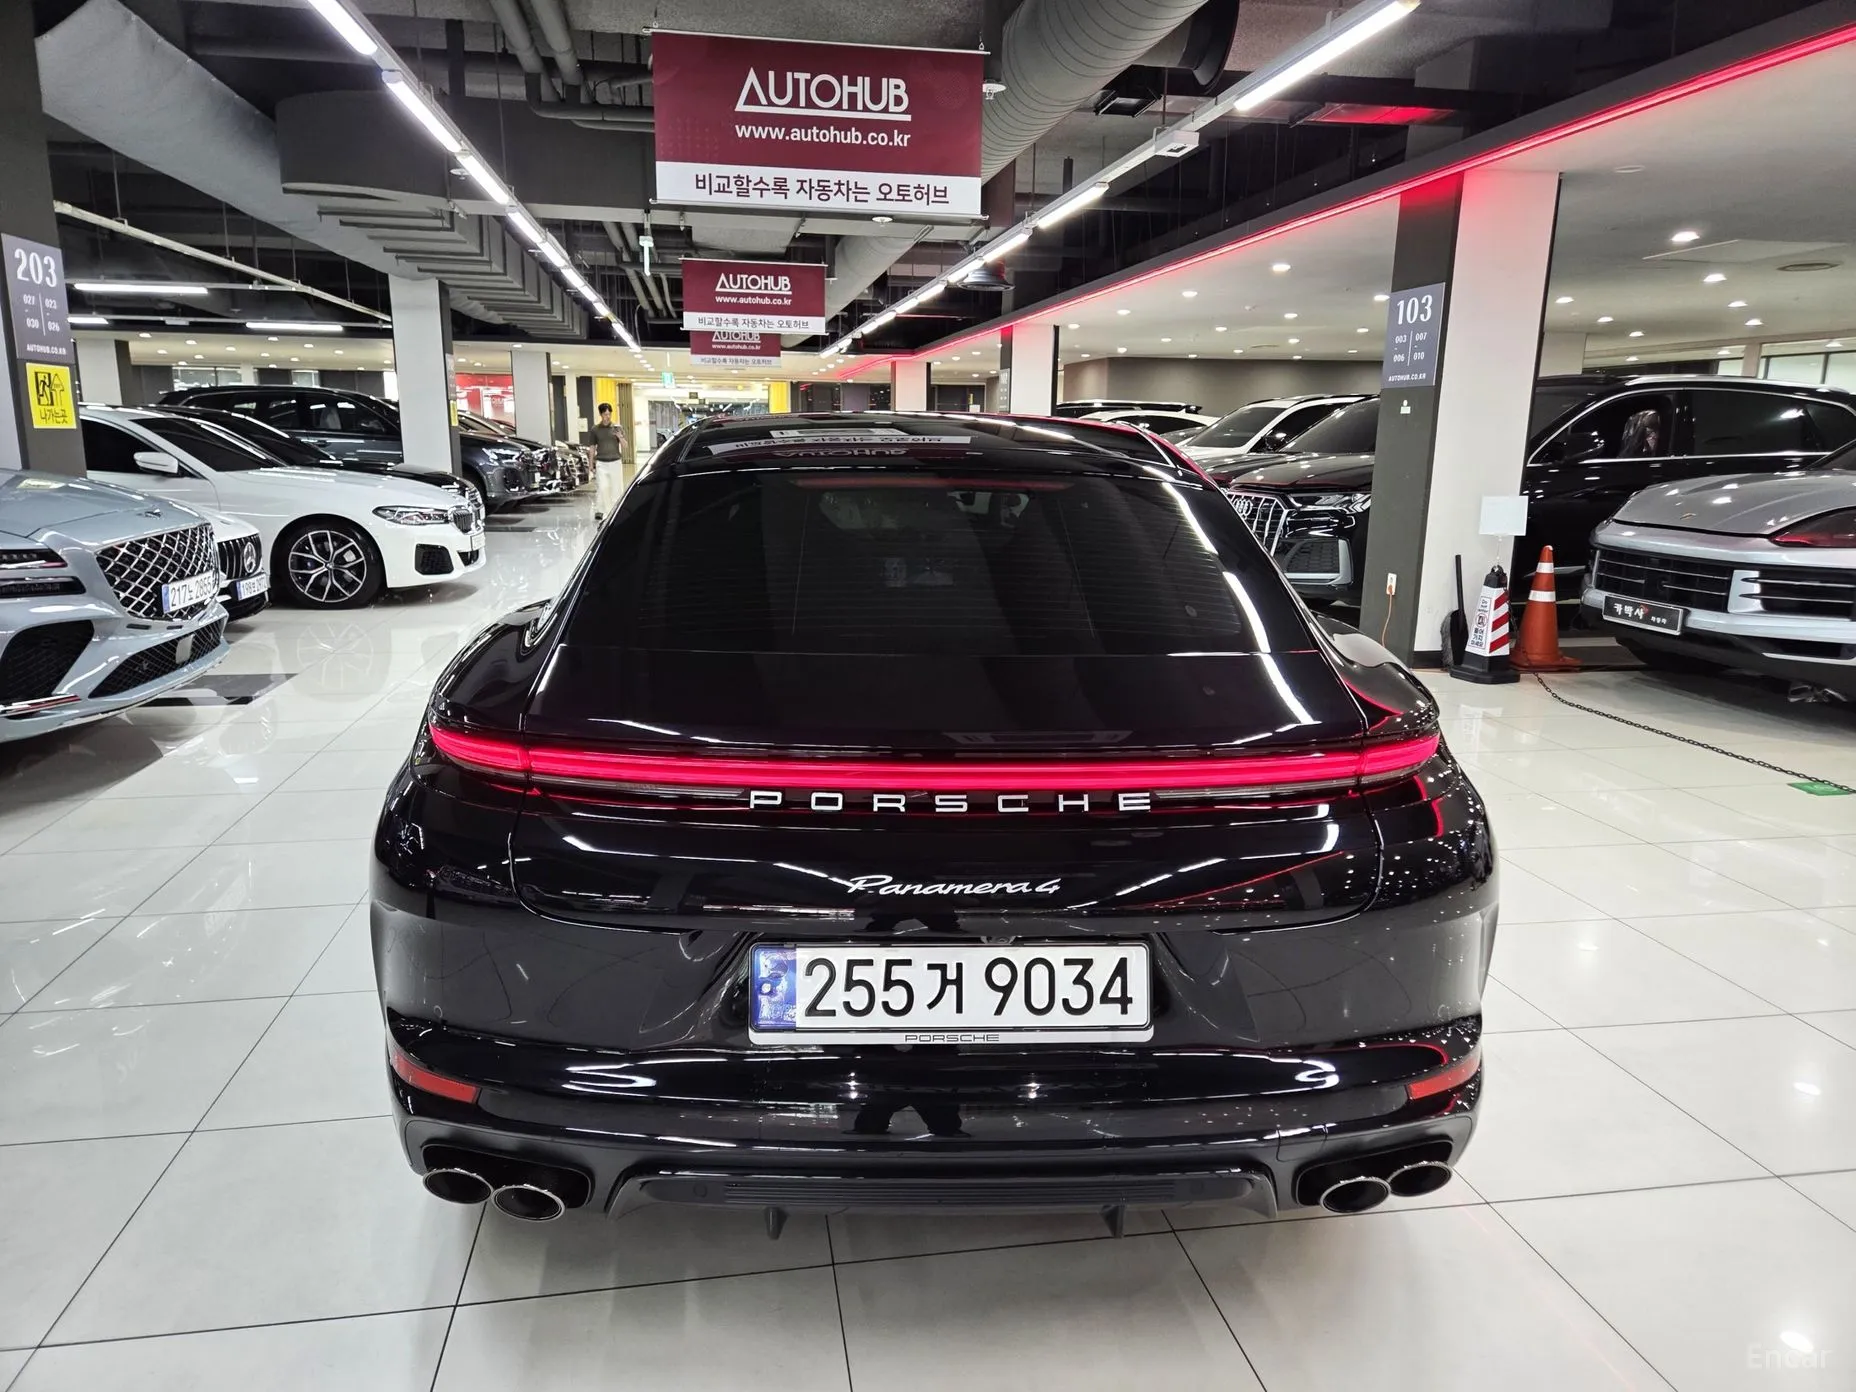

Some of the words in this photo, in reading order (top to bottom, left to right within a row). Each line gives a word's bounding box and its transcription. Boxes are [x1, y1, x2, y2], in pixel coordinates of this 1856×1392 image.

[735, 66, 911, 120] AUTOHUB
[735, 122, 911, 147] www.autohub.co.kr
[695, 172, 790, 200] 비교할수록
[796, 177, 870, 203] 자동차는
[876, 182, 949, 206] 오토허브
[14, 248, 57, 288] 203
[715, 272, 792, 294] AUTOHUB
[715, 295, 792, 306] www.autohub.co.kr
[1397, 294, 1433, 325] 103
[698, 316, 739, 328] 비교할수록
[742, 318, 774, 329] 자동차는
[777, 320, 809, 329] 오토허브
[712, 331, 760, 343] AUTOHUB
[1415, 332, 1427, 341] 007
[27, 343, 67, 355] AUTOHUB.CO.KR
[1413, 351, 1425, 361] 010
[1388, 373, 1426, 382] AUTOHUB.CO.KR
[749, 791, 1151, 813] PORSCHE
[847, 874, 1032, 894] Panamera
[1035, 878, 1061, 894] 4
[804, 958, 964, 1017] 255거
[984, 957, 1133, 1017] 9034
[905, 1034, 999, 1043] PORSCHE
